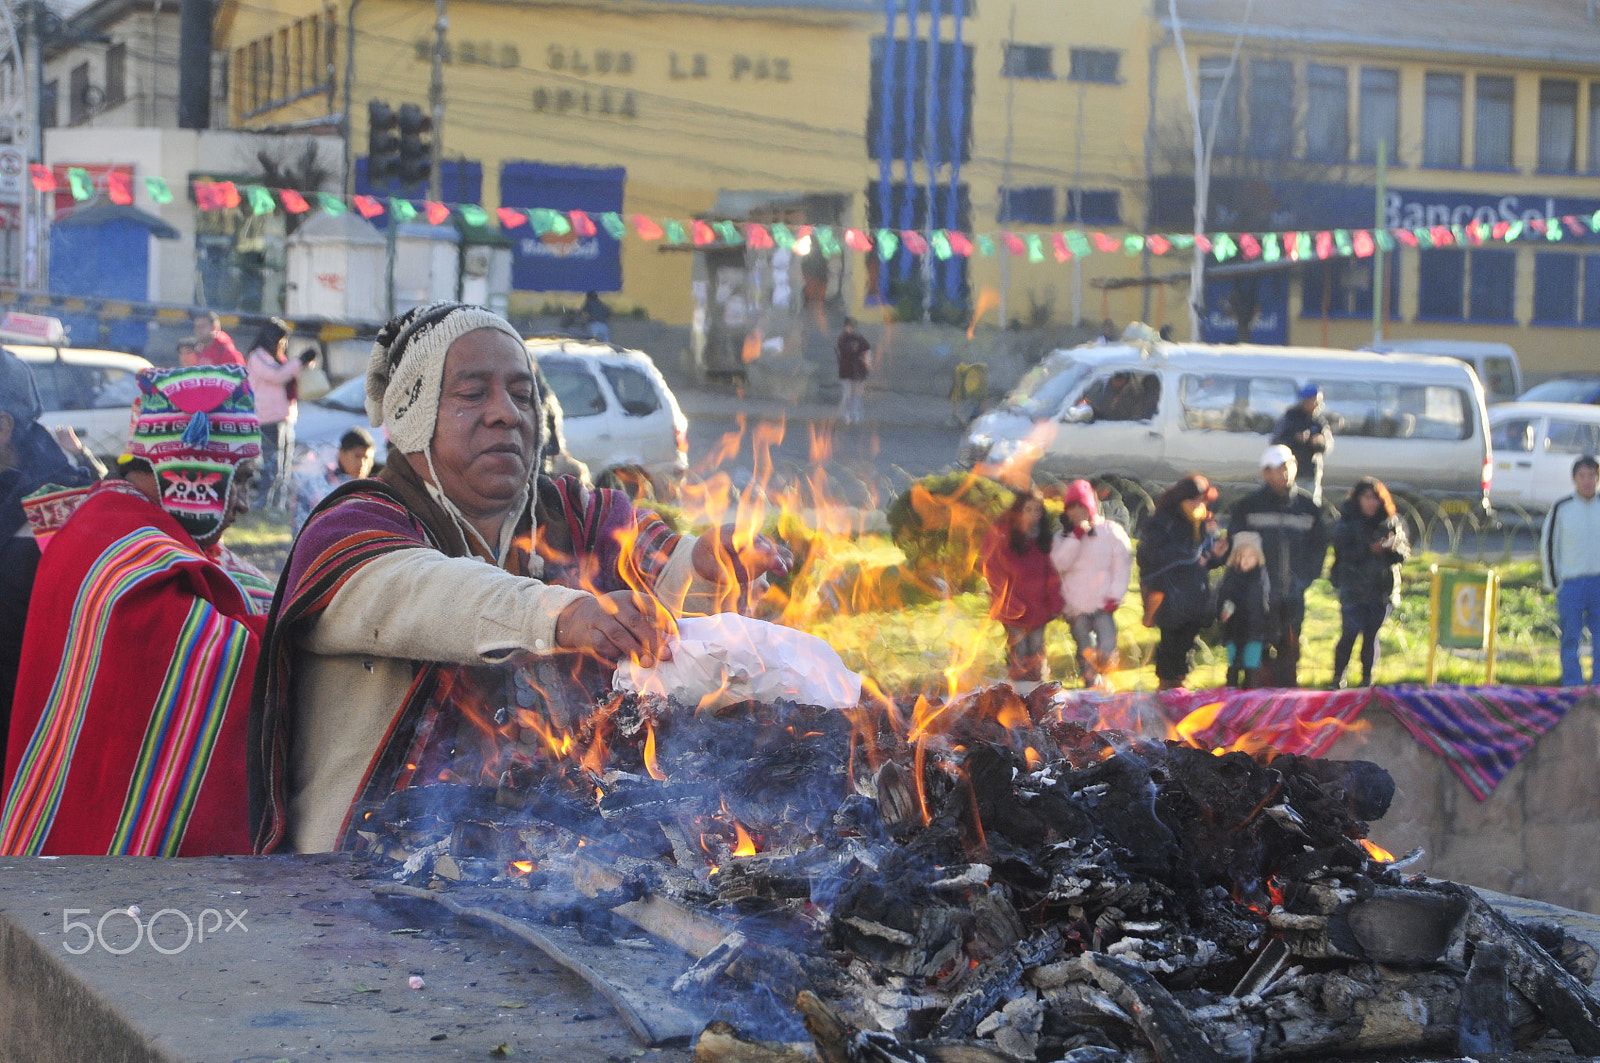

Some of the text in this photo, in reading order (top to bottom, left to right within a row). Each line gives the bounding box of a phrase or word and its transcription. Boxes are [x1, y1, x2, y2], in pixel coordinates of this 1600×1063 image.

[668, 51, 708, 80] LA
[731, 53, 792, 83] PAZ
[1384, 192, 1555, 240] BancoSol
